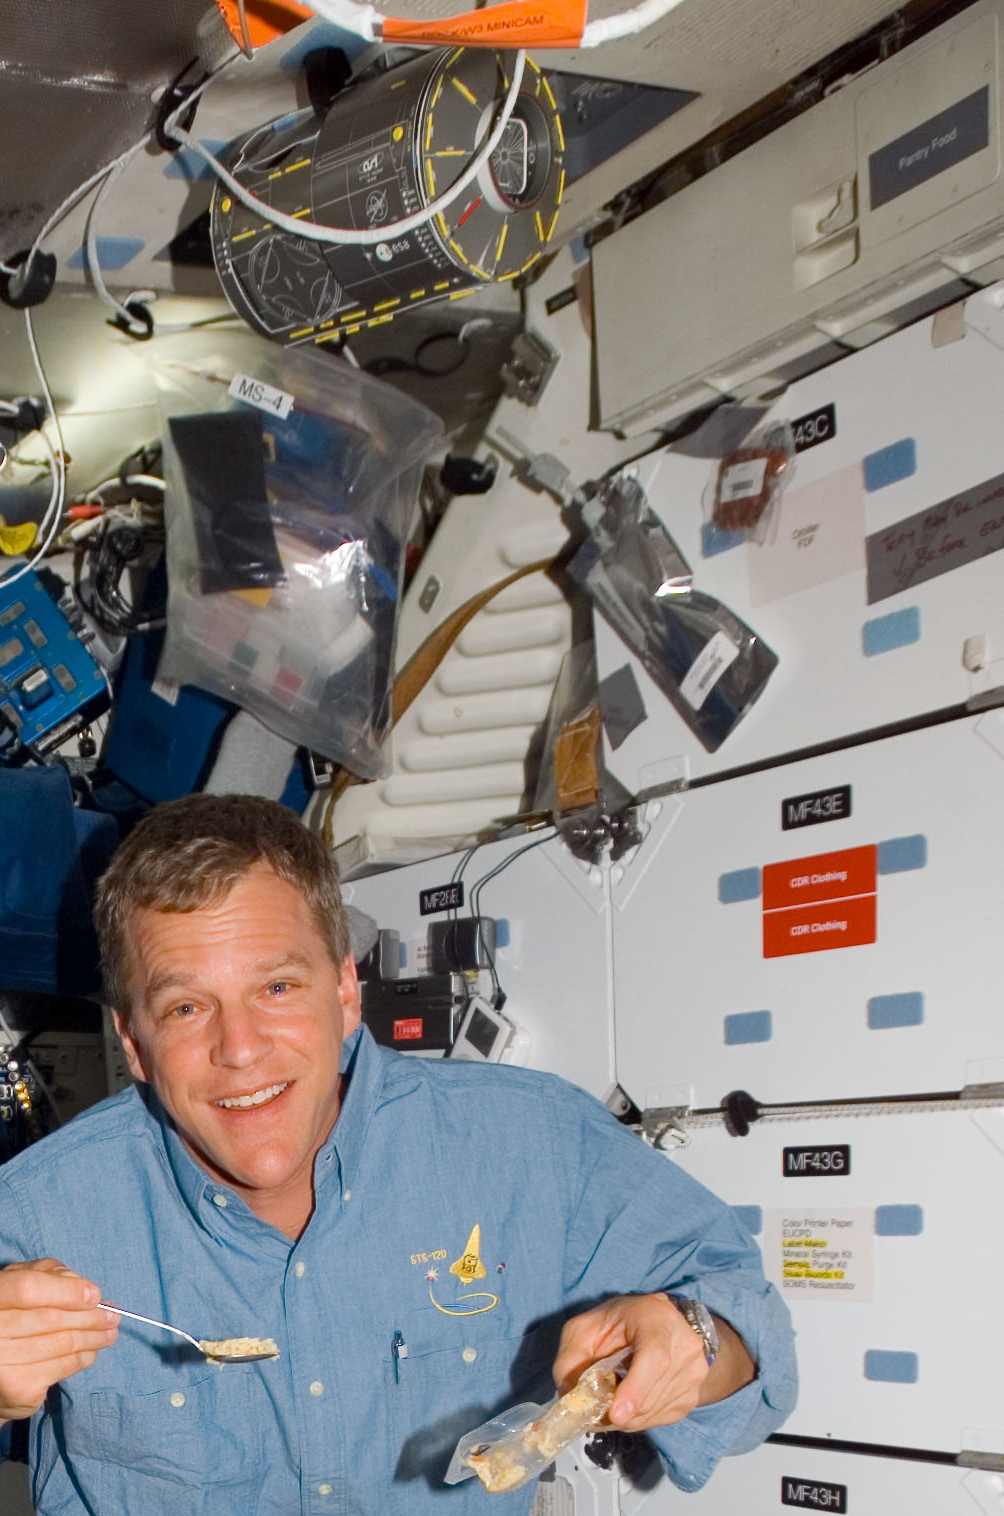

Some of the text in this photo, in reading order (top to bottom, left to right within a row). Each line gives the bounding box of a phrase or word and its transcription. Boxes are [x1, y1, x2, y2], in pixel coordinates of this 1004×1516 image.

[487, 15, 545, 32] MINICAM
[898, 127, 957, 171] Pantry Food
[238, 378, 284, 411] MS-4
[788, 793, 844, 824] MF43E
[790, 870, 848, 889] CDR Clothing
[790, 919, 848, 937] CDR Clothing
[788, 1151, 844, 1171] MF43G
[782, 1218, 854, 1230] Color Printer Paper
[787, 1483, 841, 1508] MF43H
